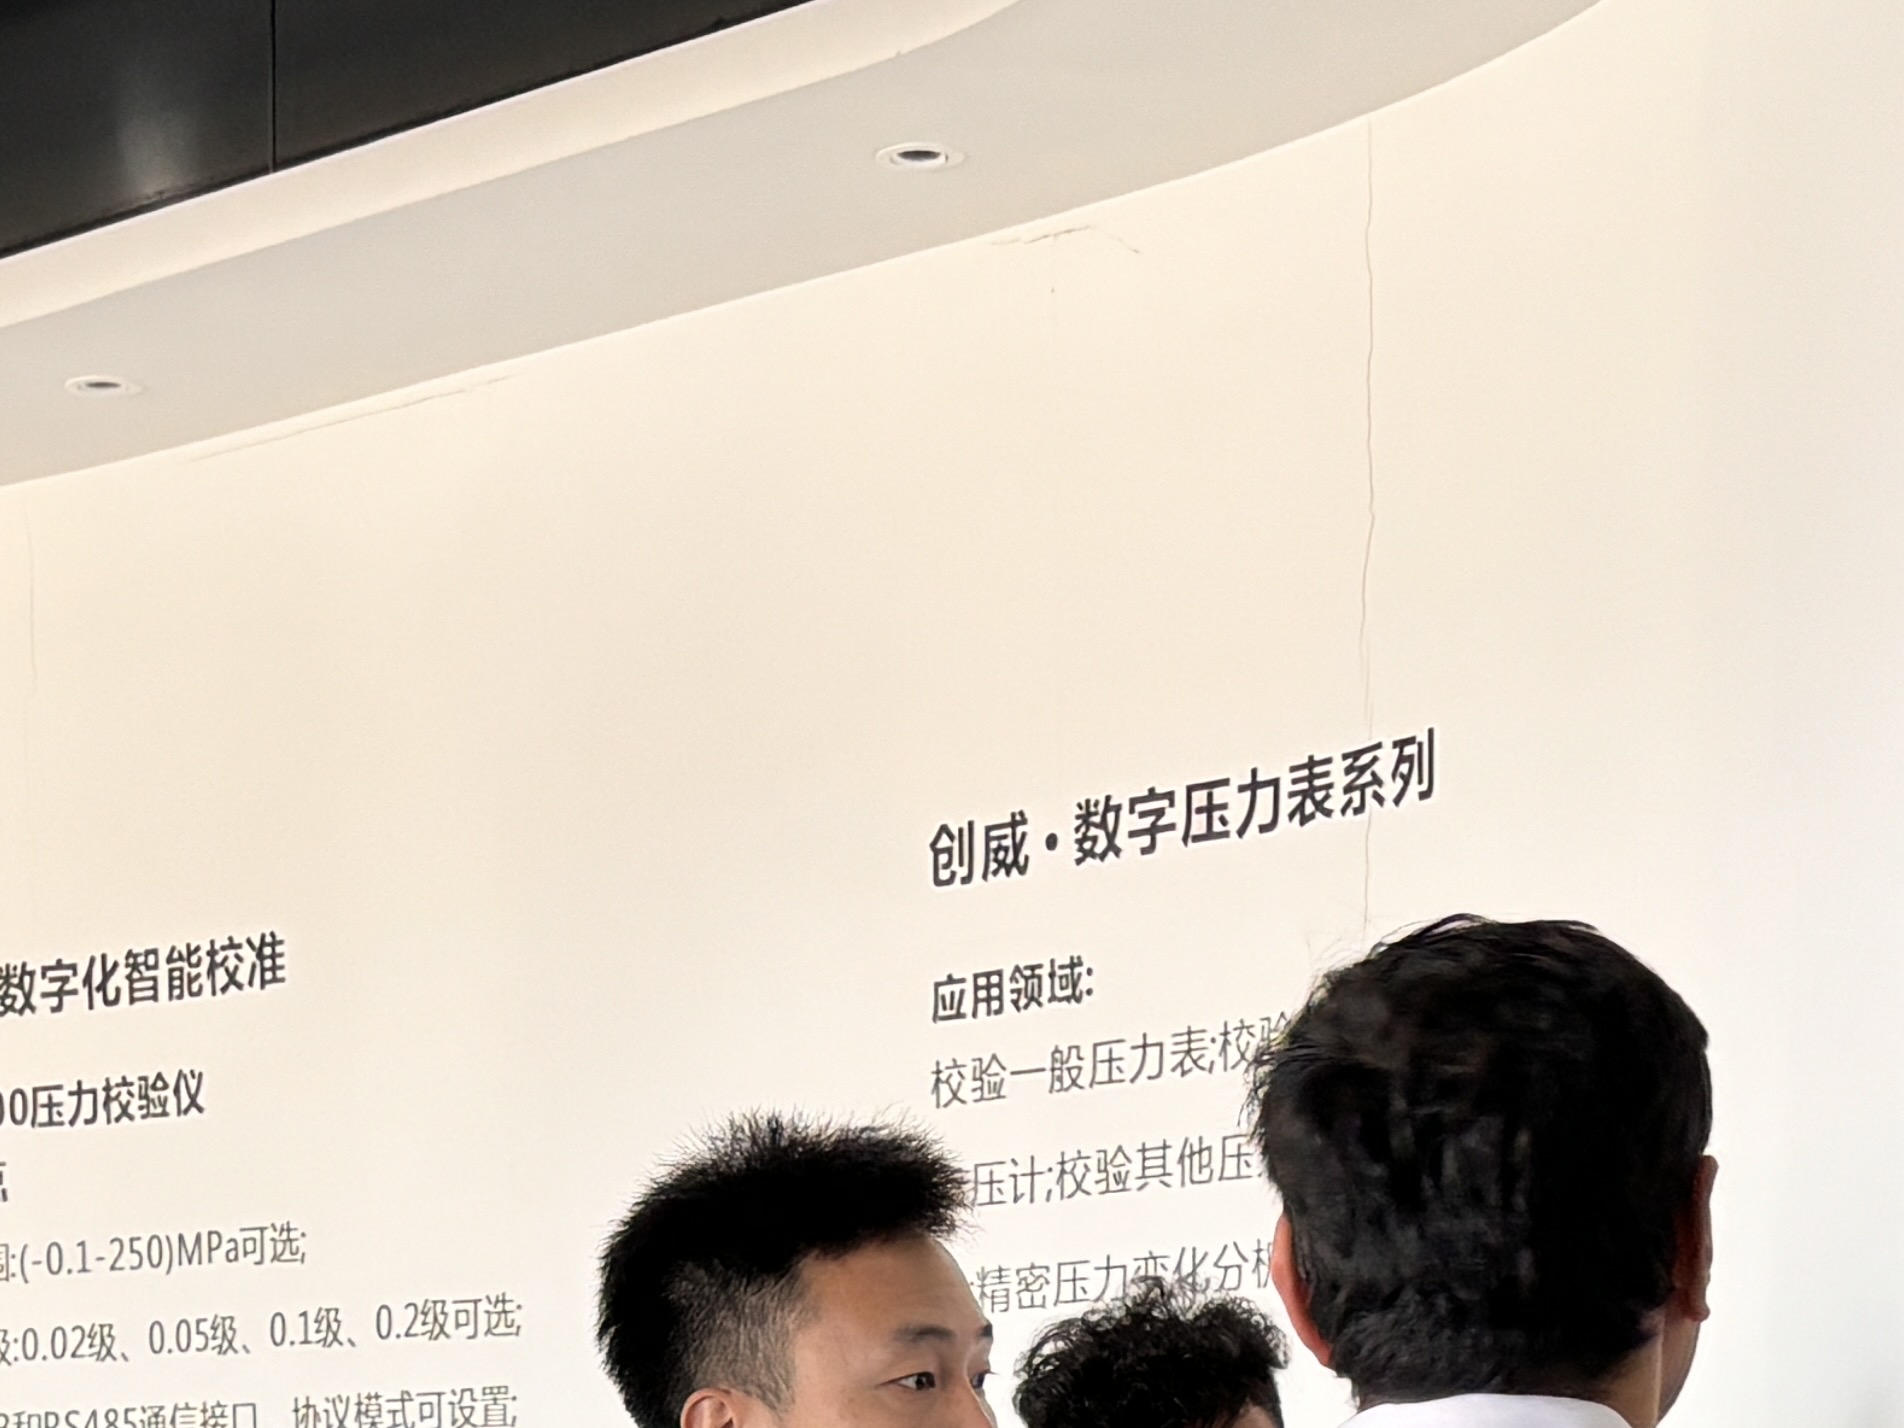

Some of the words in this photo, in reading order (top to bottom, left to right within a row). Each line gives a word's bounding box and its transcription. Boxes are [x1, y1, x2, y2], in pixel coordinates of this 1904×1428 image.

[931, 955, 1095, 1024] 应用领域:
[960, 1133, 1262, 1209] 压计;校验其他压
[970, 1239, 1272, 1315] 精密压力变化分
